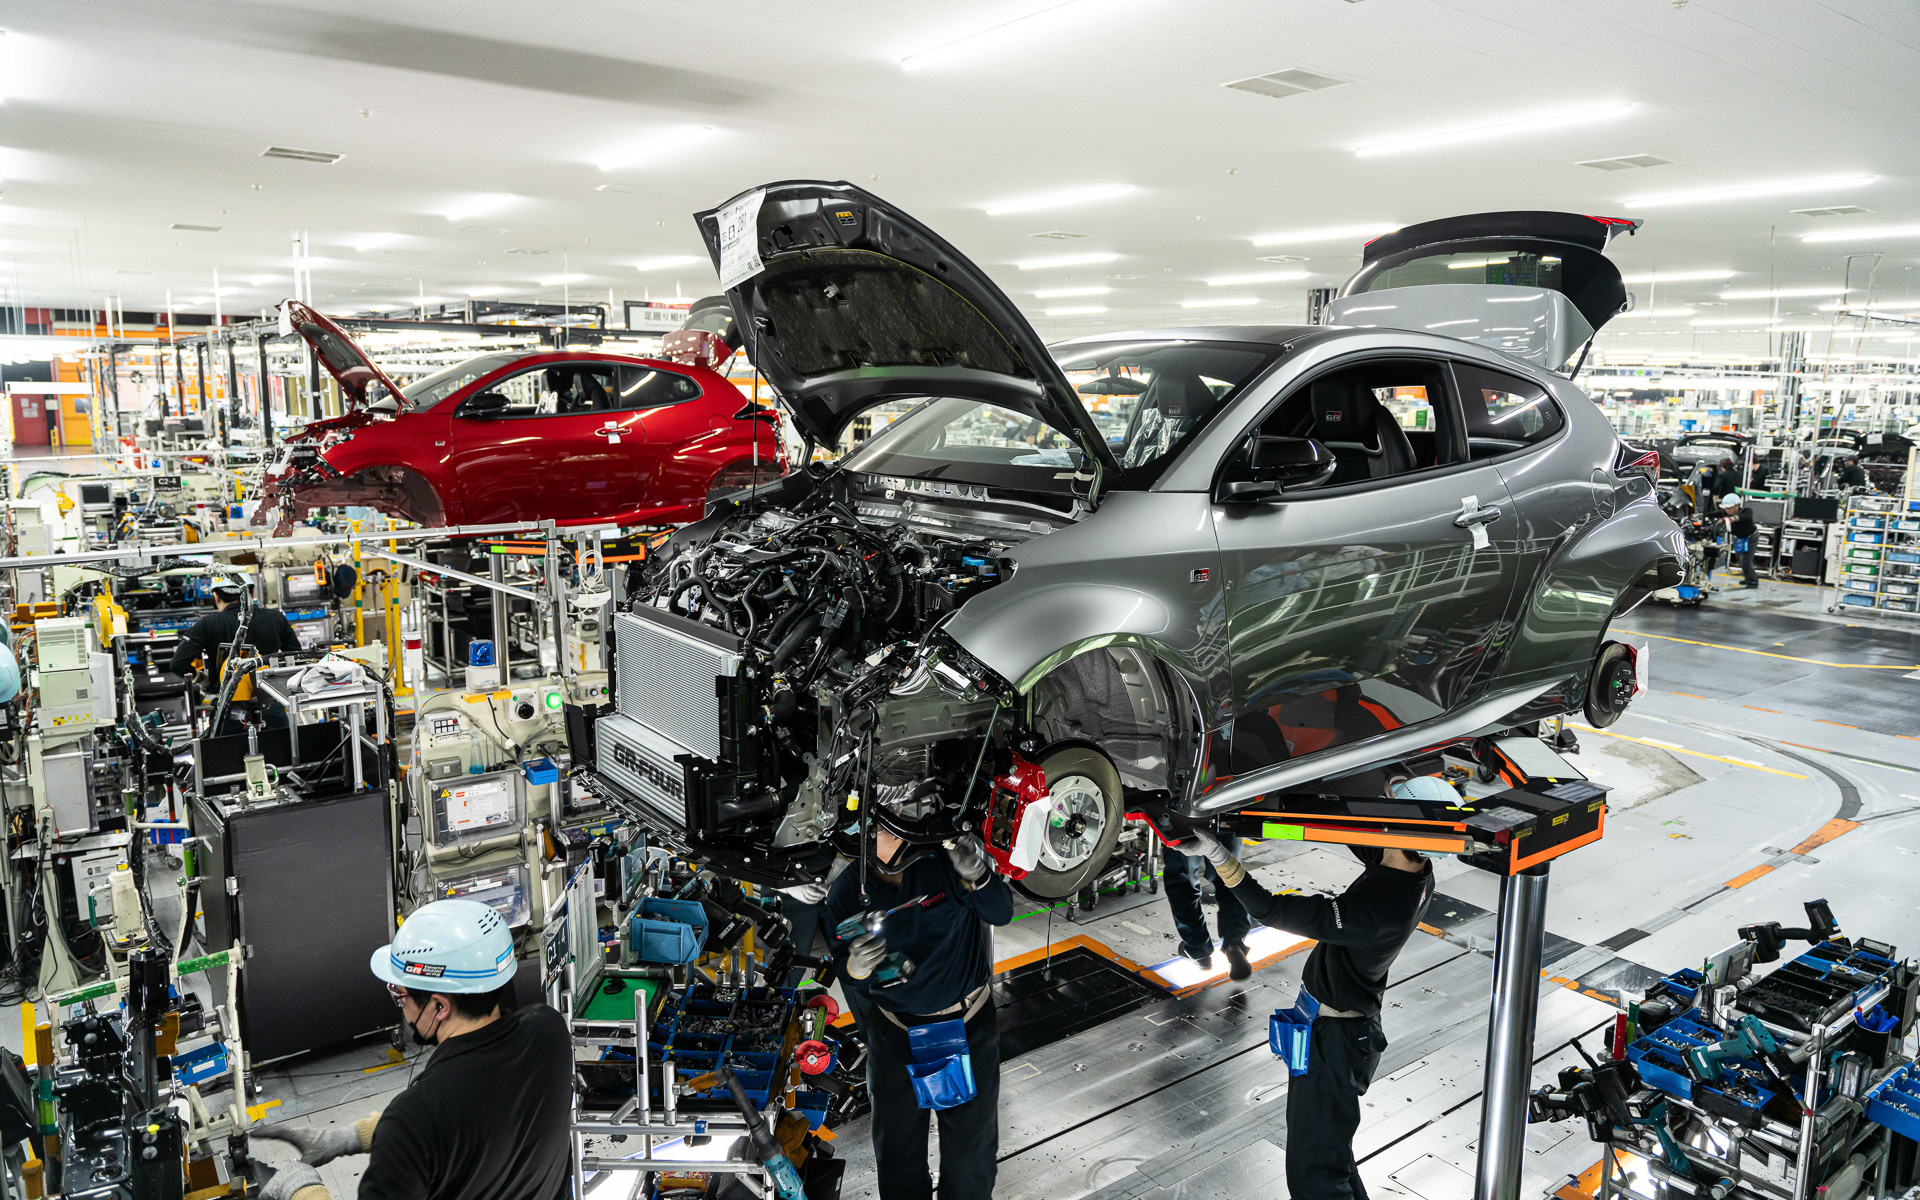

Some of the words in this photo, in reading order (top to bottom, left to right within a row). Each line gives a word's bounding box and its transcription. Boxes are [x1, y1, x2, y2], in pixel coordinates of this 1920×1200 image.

[158, 477, 177, 485] C2-4
[614, 743, 684, 801] GR-FOUR
[920, 892, 947, 908] TOYOTA
[405, 965, 422, 975] GR
